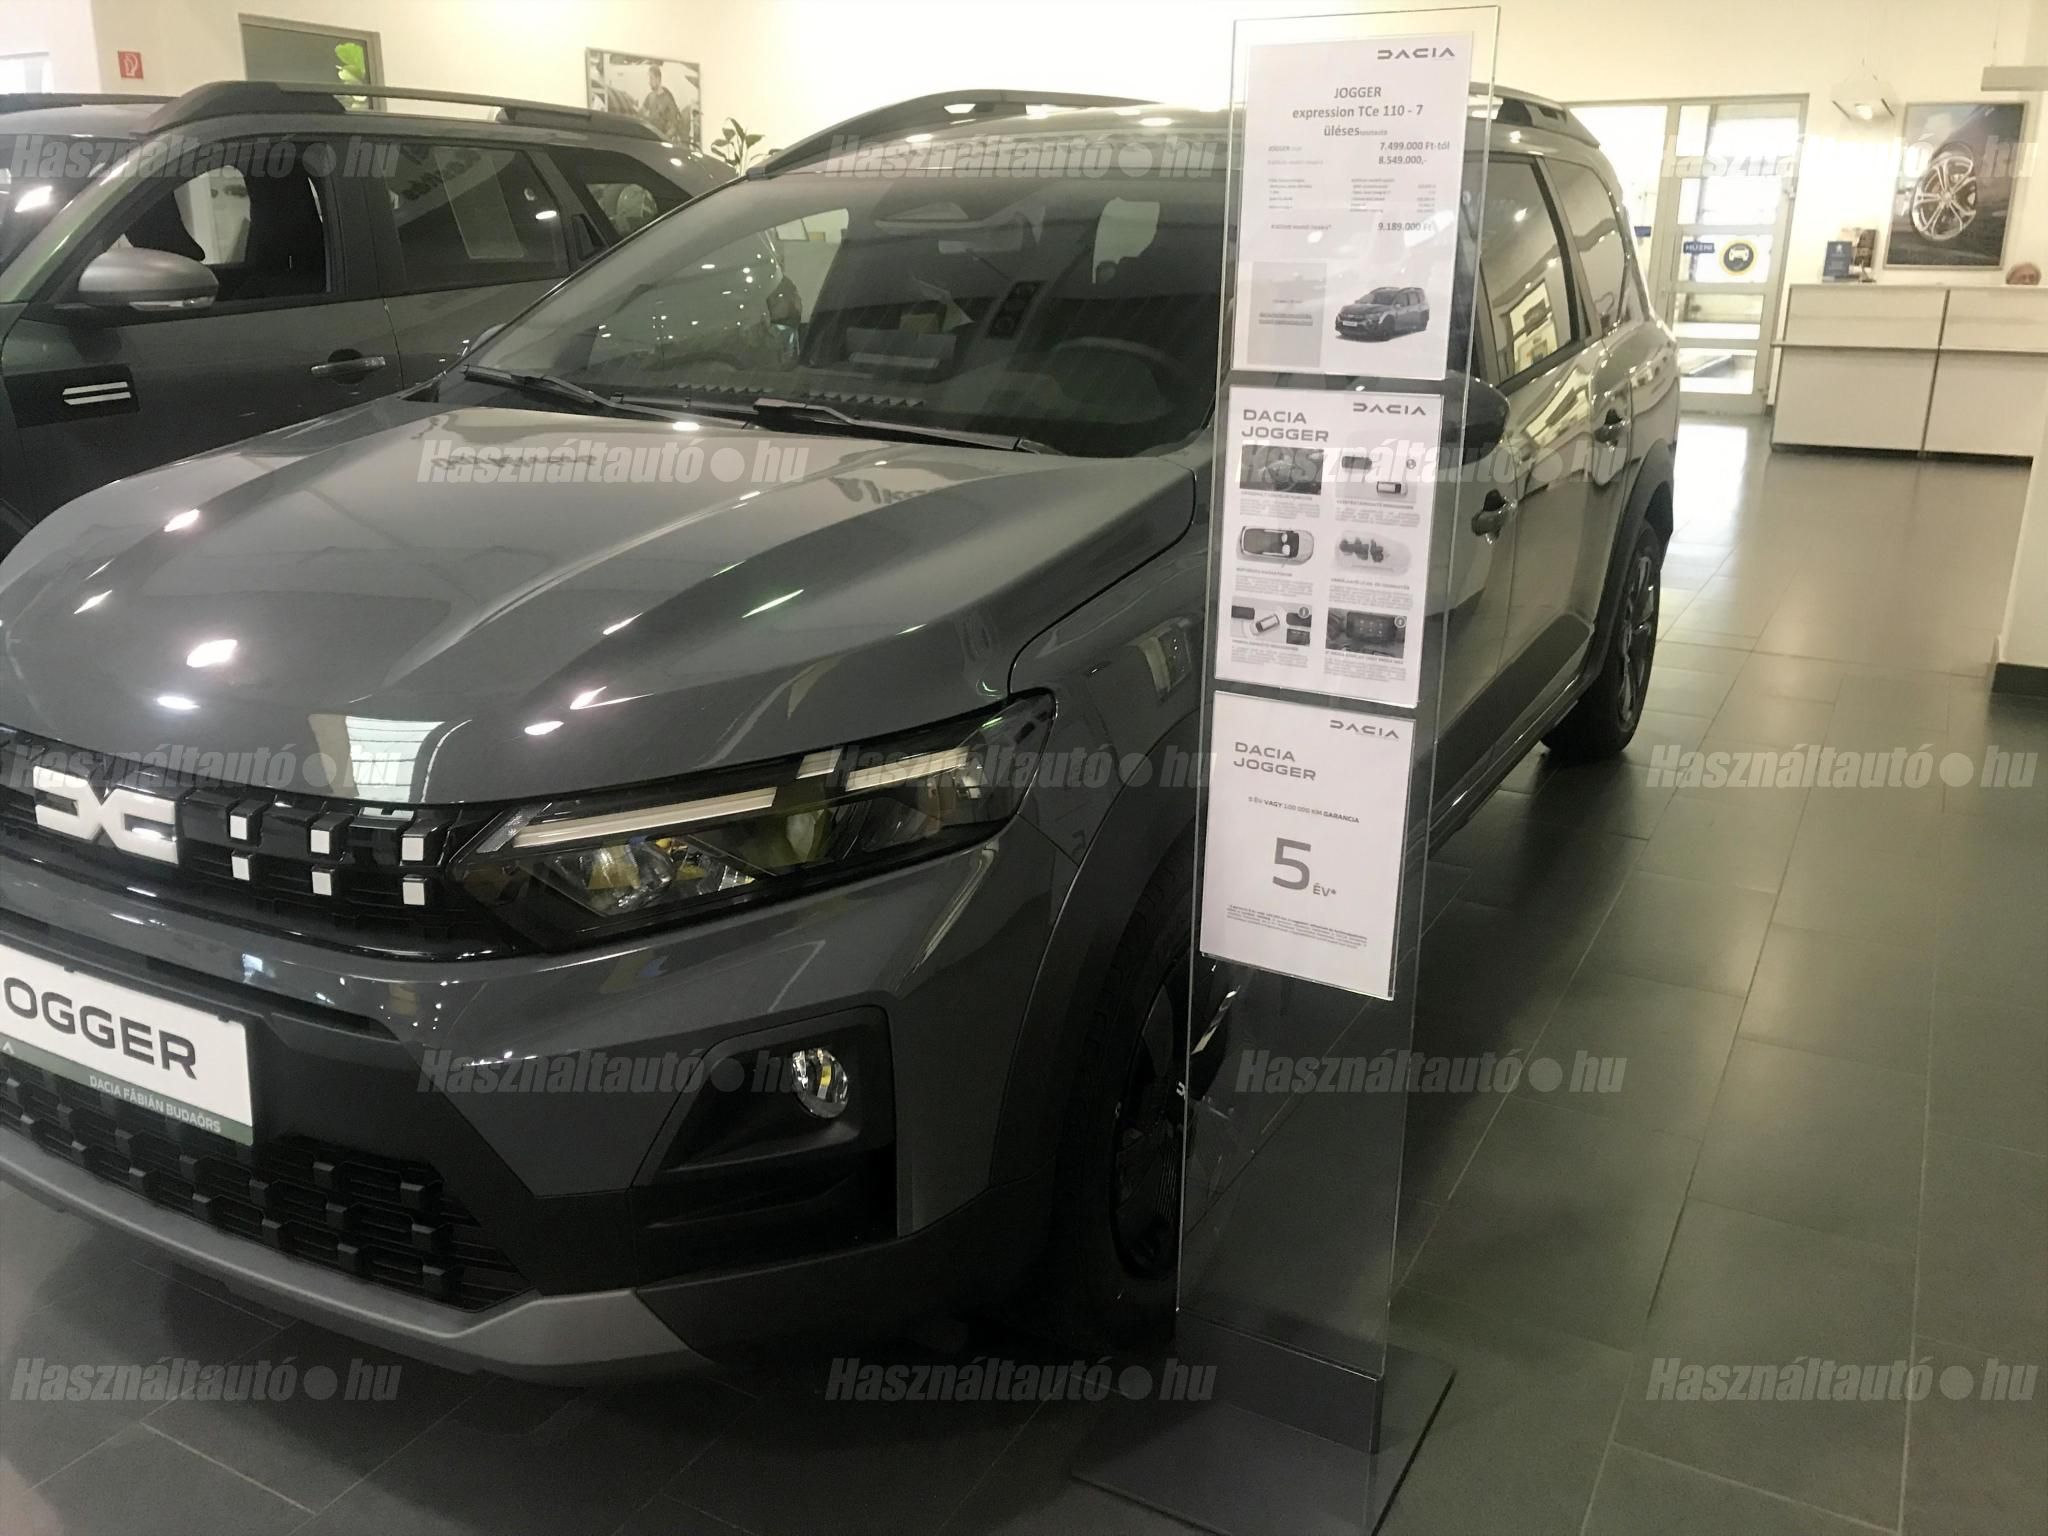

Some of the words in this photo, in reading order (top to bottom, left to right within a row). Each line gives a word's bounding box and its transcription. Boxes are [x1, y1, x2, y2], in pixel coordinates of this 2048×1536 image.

[1377, 47, 1455, 60] DACIA
[1334, 86, 1382, 99] JOGGER
[1292, 106, 1355, 121] expression
[1358, 105, 1380, 117] TCe
[1383, 105, 1405, 117] 110
[1416, 104, 1424, 116] 7
[1379, 141, 1424, 151] 7.499.000
[1378, 222, 1421, 231] 9.189.000
[1243, 409, 1307, 424] DACIA
[1352, 402, 1426, 416] DACIA
[1241, 426, 1329, 442] JOGGER
[1329, 719, 1400, 739] DACIA
[1234, 741, 1295, 762] DACIA
[1233, 757, 1316, 781] JOGGER
[1263, 799, 1282, 808] VAGY
[1323, 811, 1360, 823] GARANCIA
[1272, 837, 1312, 891] 5
[89, 1074, 122, 1097] DACIA
[123, 1087, 164, 1115] FÁBIÁN
